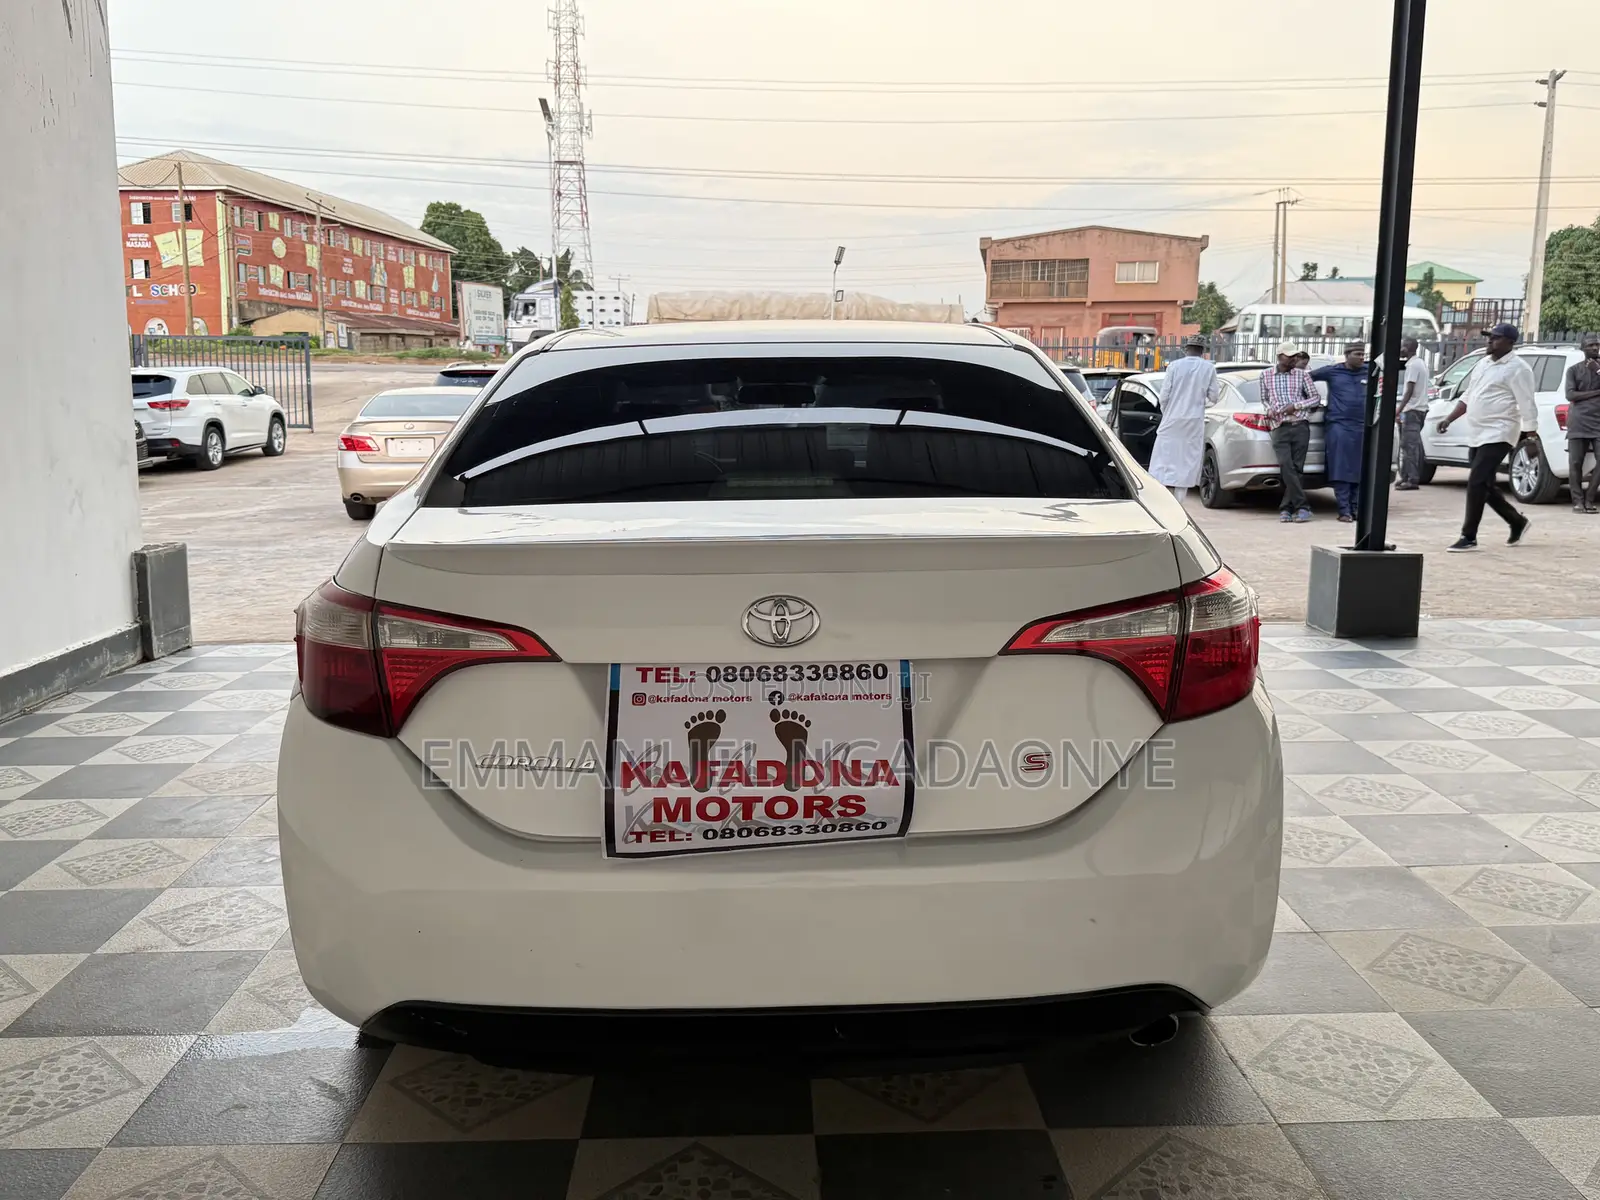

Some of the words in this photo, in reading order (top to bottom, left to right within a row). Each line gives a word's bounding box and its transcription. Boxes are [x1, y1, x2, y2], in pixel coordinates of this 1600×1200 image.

[150, 283, 207, 297] SCHOOL
[635, 666, 697, 684] TEL:
[705, 663, 889, 683] 08068330860
[712, 694, 753, 703] motors
[852, 691, 892, 701] motors
[475, 753, 599, 774] COROLLA
[1020, 751, 1053, 774] S
[620, 759, 900, 789] KAFADONA
[653, 794, 867, 824] MOTORS
[628, 830, 693, 844] TEL:
[702, 821, 888, 841] 08068330860
